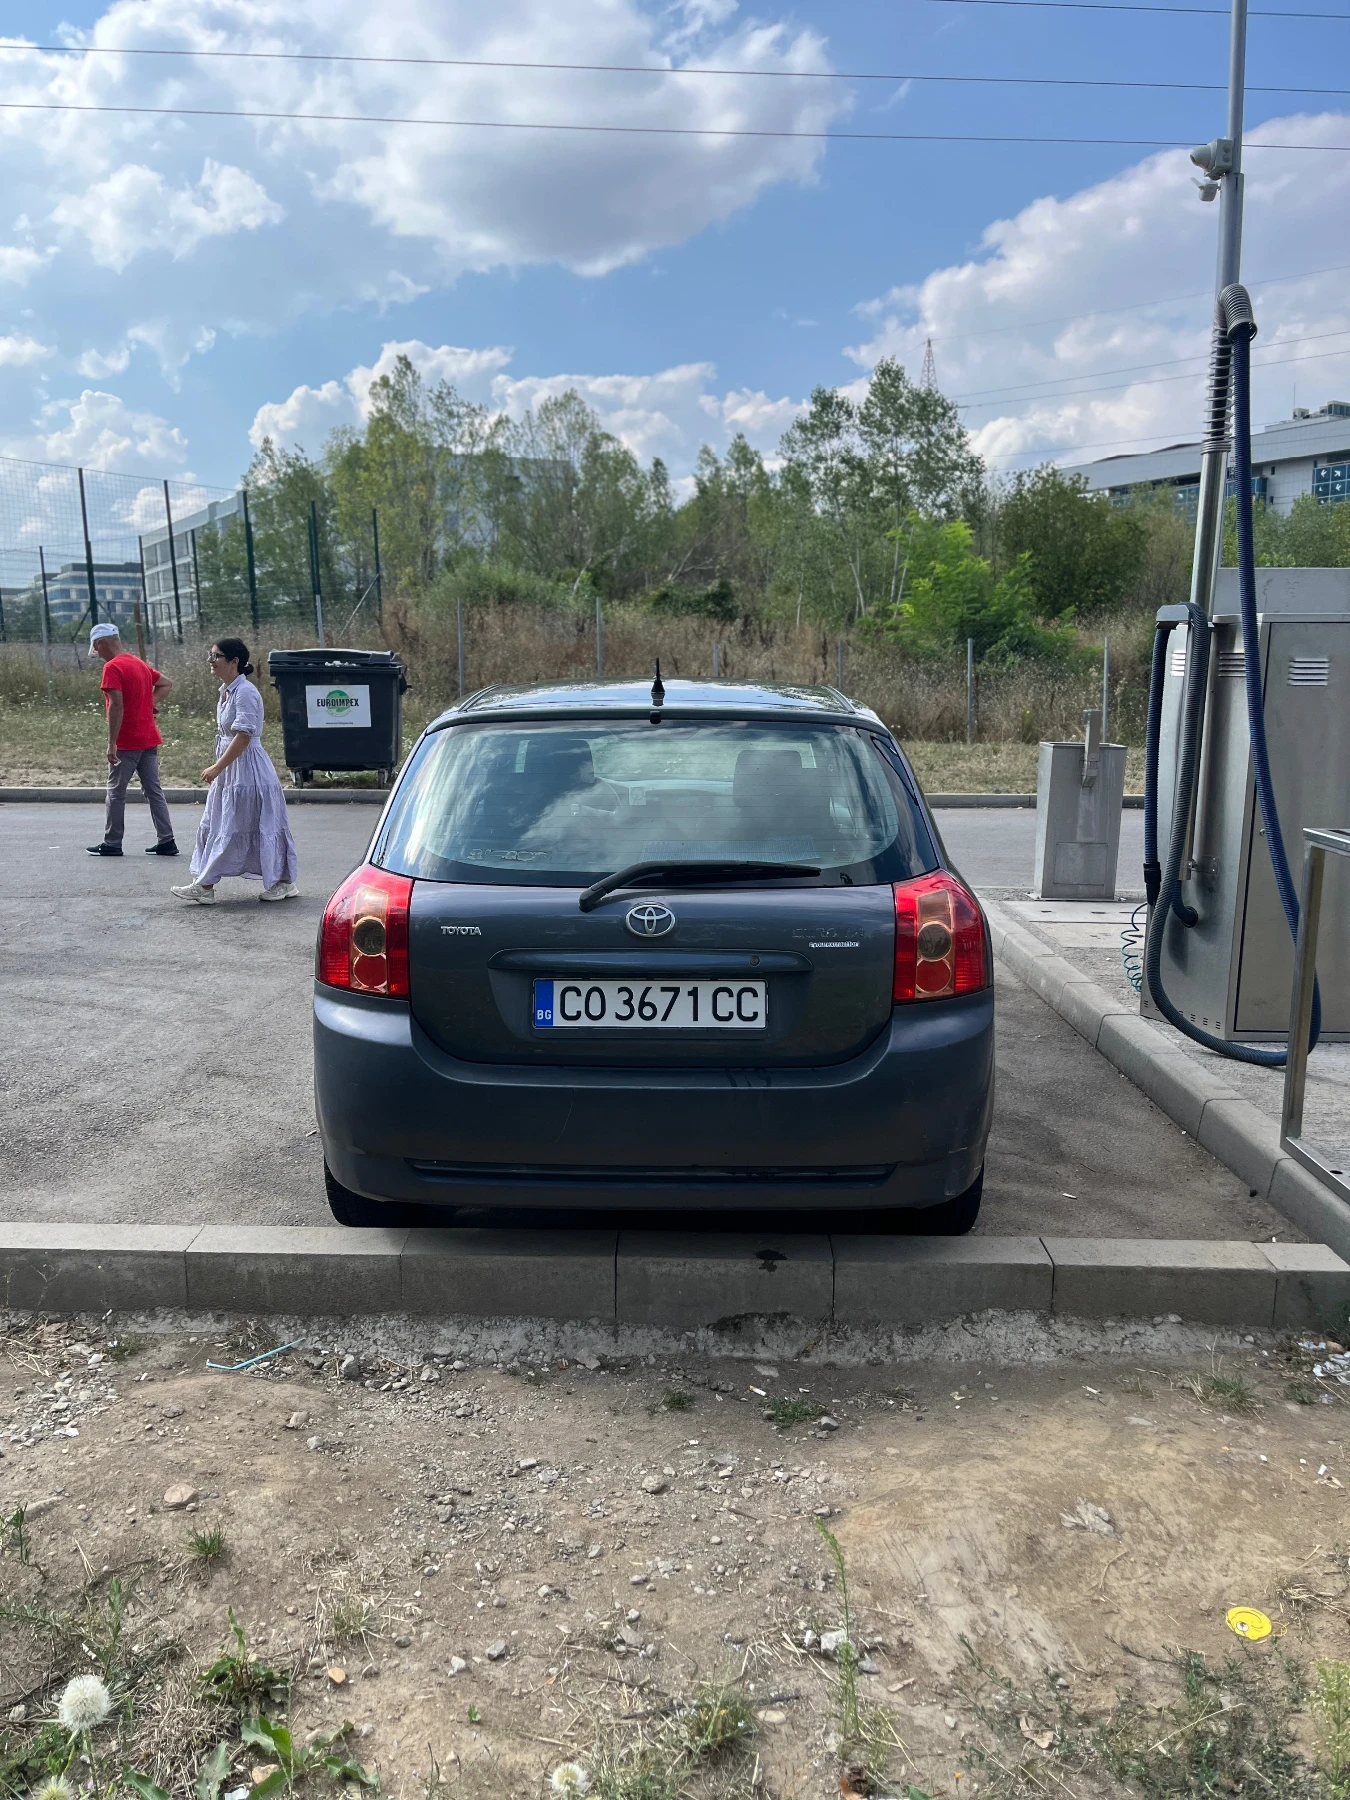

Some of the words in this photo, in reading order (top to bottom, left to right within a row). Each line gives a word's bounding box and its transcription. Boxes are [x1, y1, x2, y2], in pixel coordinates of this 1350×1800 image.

[316, 698, 360, 707] EUROIMPEX
[440, 925, 482, 936] TOYOTA
[614, 986, 699, 1022] 3671
[711, 986, 759, 1022] CC
[536, 1009, 552, 1020] BG
